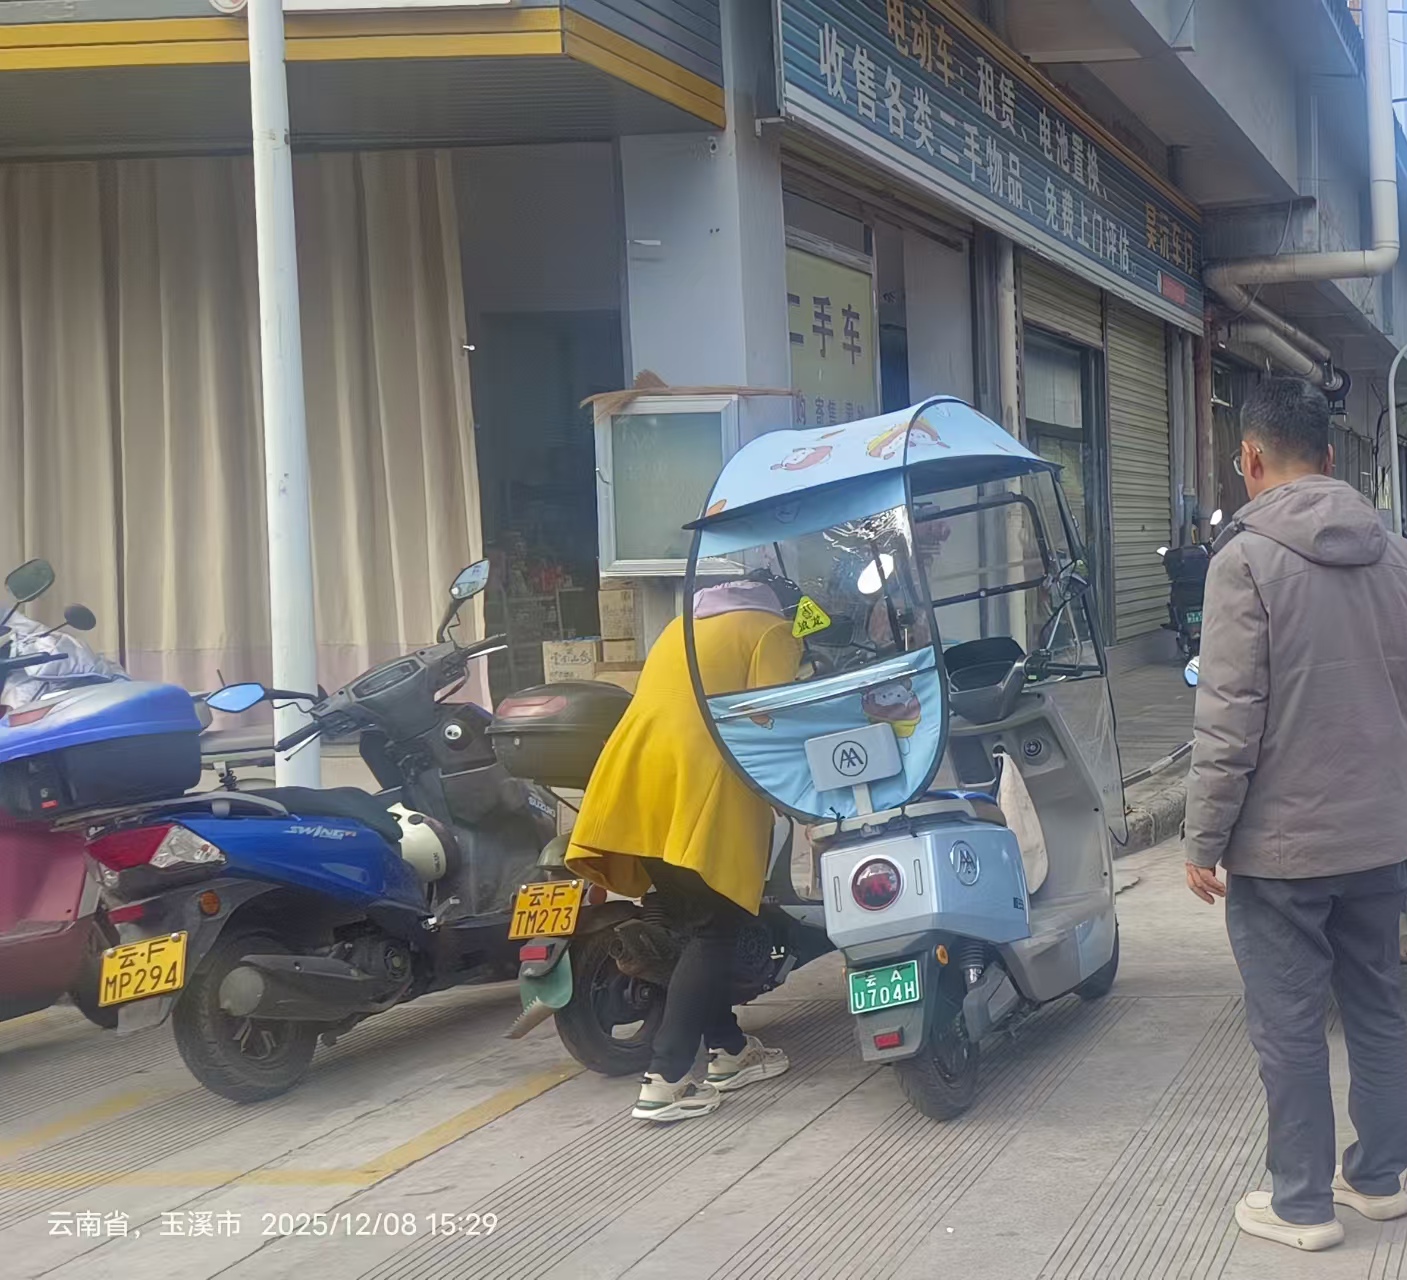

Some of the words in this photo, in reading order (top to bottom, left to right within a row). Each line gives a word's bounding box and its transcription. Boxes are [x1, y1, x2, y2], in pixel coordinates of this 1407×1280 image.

[285, 825, 344, 840] SWING
[516, 907, 573, 936] TM273
[104, 961, 178, 1001] MP294
[854, 981, 915, 1009] U704H
